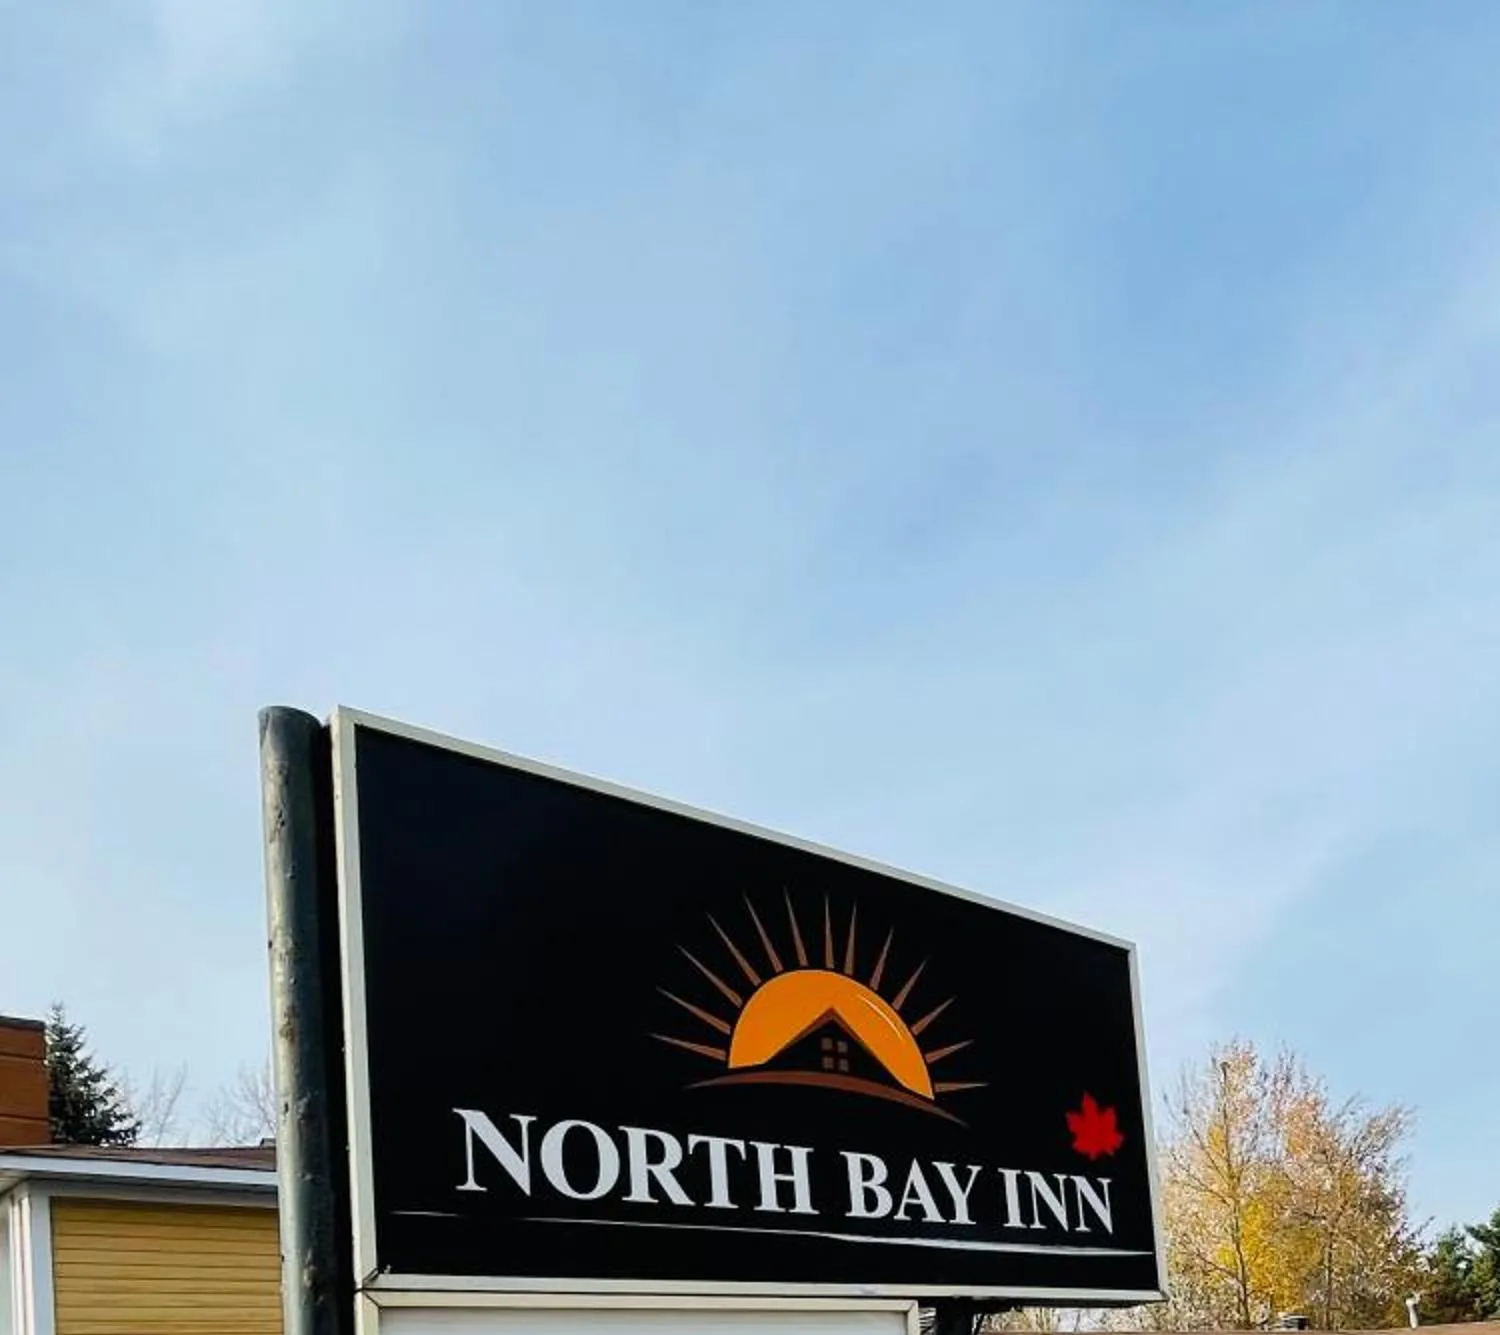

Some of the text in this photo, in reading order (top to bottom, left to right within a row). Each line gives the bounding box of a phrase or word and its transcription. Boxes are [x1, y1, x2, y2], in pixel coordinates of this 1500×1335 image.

[453, 1108, 1113, 1234] NORTH BAY INN
